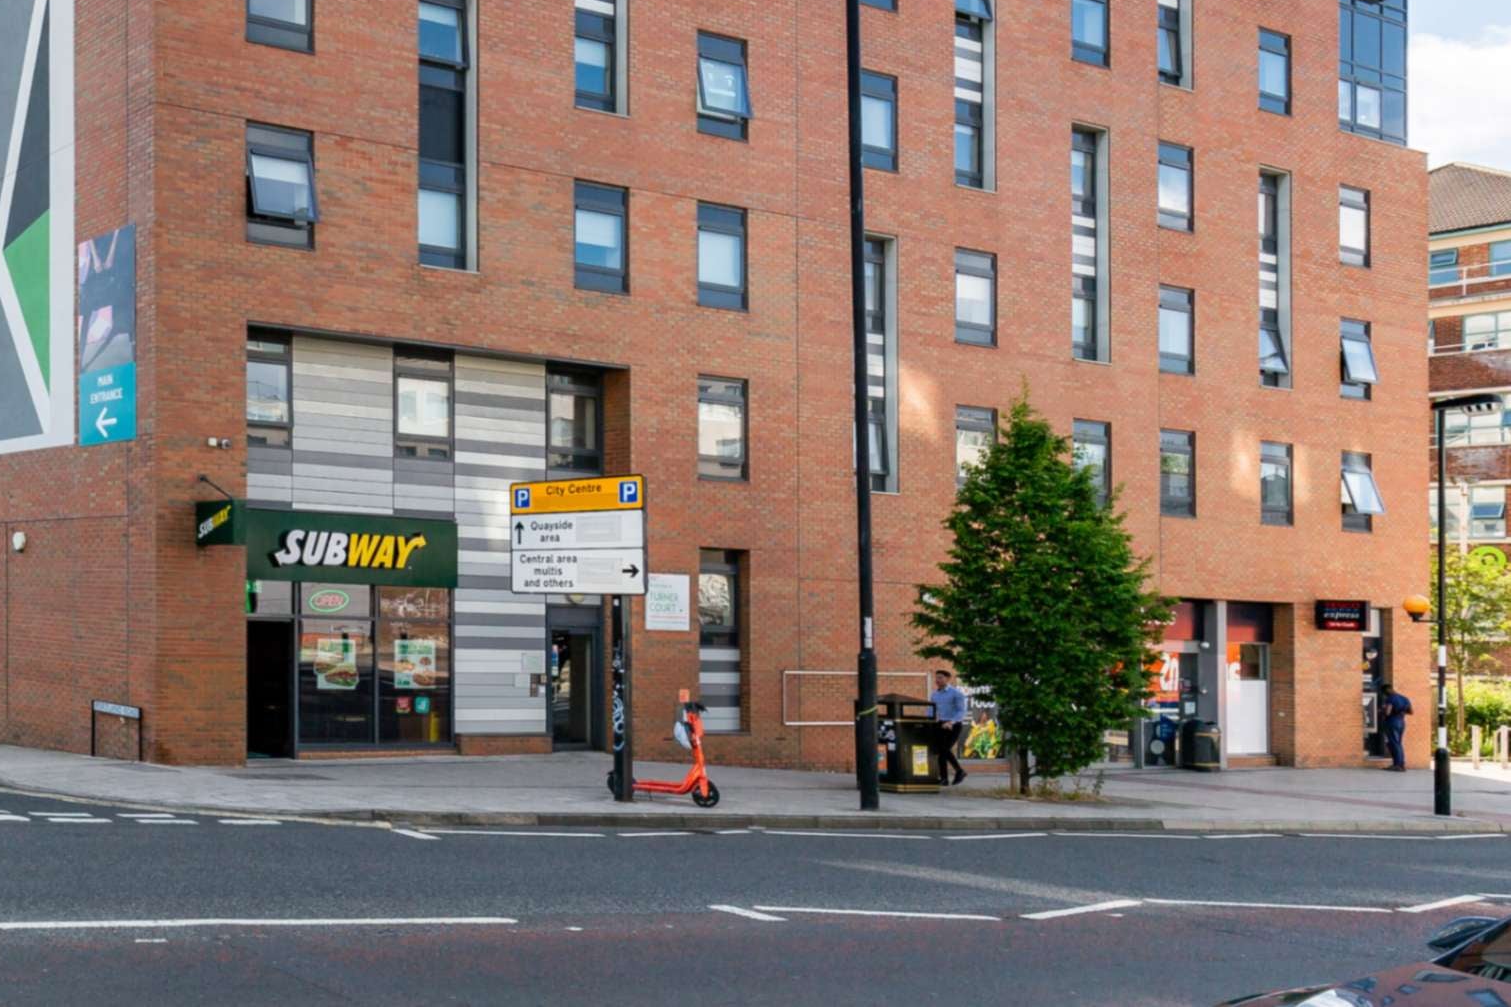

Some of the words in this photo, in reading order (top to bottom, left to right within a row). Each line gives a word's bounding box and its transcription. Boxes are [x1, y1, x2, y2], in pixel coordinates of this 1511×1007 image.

[90, 388, 123, 404] ENTRANCE
[546, 486, 565, 496] City
[568, 483, 602, 494] Centre
[623, 484, 636, 501] P
[517, 490, 528, 507] P
[198, 505, 231, 539] SUBWAY
[530, 521, 573, 531] Quayside
[540, 534, 560, 542] area
[275, 529, 427, 569] SUBWAY
[519, 554, 554, 564] Central
[556, 555, 578, 563] area
[524, 579, 540, 587] and
[543, 579, 574, 587] others
